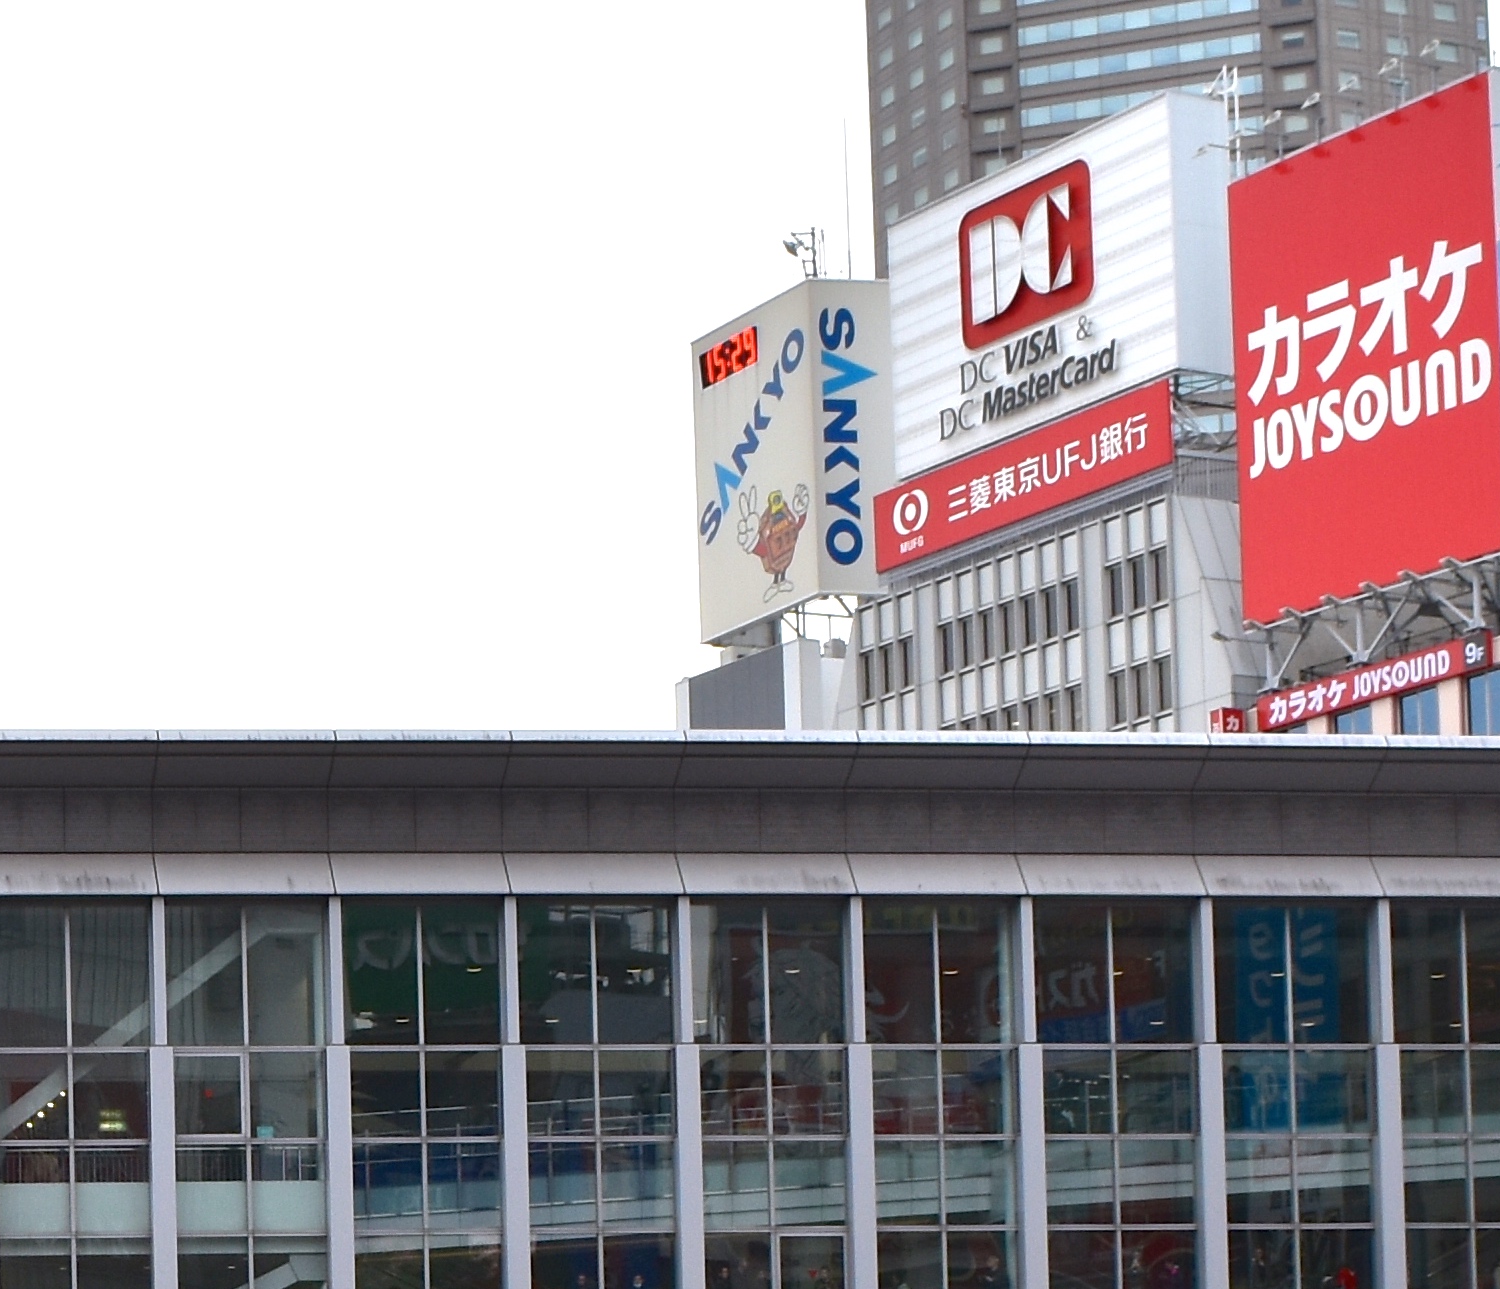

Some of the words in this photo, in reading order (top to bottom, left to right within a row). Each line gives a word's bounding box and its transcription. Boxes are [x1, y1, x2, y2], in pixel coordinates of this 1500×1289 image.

[968, 181, 1074, 326] DC
[706, 325, 757, 384] 15:29
[960, 349, 996, 396] DC
[1001, 323, 1059, 375] VISA
[1075, 314, 1094, 341] &
[1246, 239, 1483, 406] カラオケ
[700, 327, 806, 546] SANKYO
[819, 307, 879, 566] SANKYO
[939, 393, 975, 441] DC
[981, 339, 1117, 422] MasterCard
[1249, 336, 1494, 480] JOYSOUND
[947, 411, 1149, 525] 三菱東京UFJ銀行
[900, 534, 925, 554] MUFG
[1268, 679, 1347, 725] カラオケ
[1352, 649, 1450, 701] JOYSOUND
[1464, 643, 1485, 665] 9F
